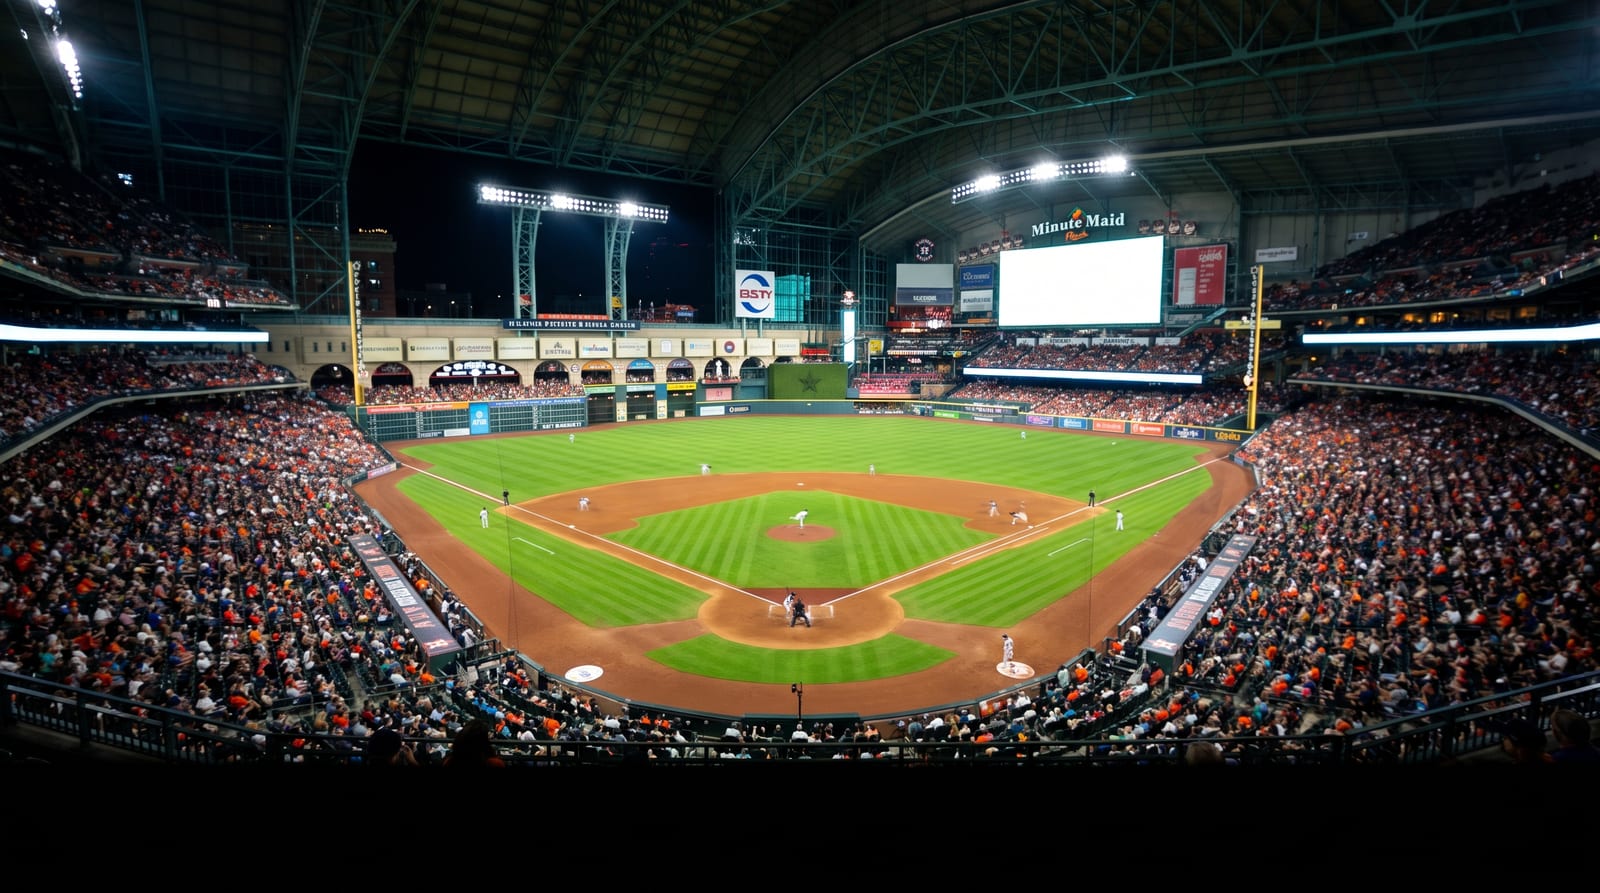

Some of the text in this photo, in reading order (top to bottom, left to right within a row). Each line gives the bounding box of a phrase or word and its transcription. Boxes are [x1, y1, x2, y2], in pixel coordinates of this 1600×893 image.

[1032, 218, 1082, 237] Minute
[1086, 213, 1125, 227] Maid
[740, 289, 773, 299] BSTY
